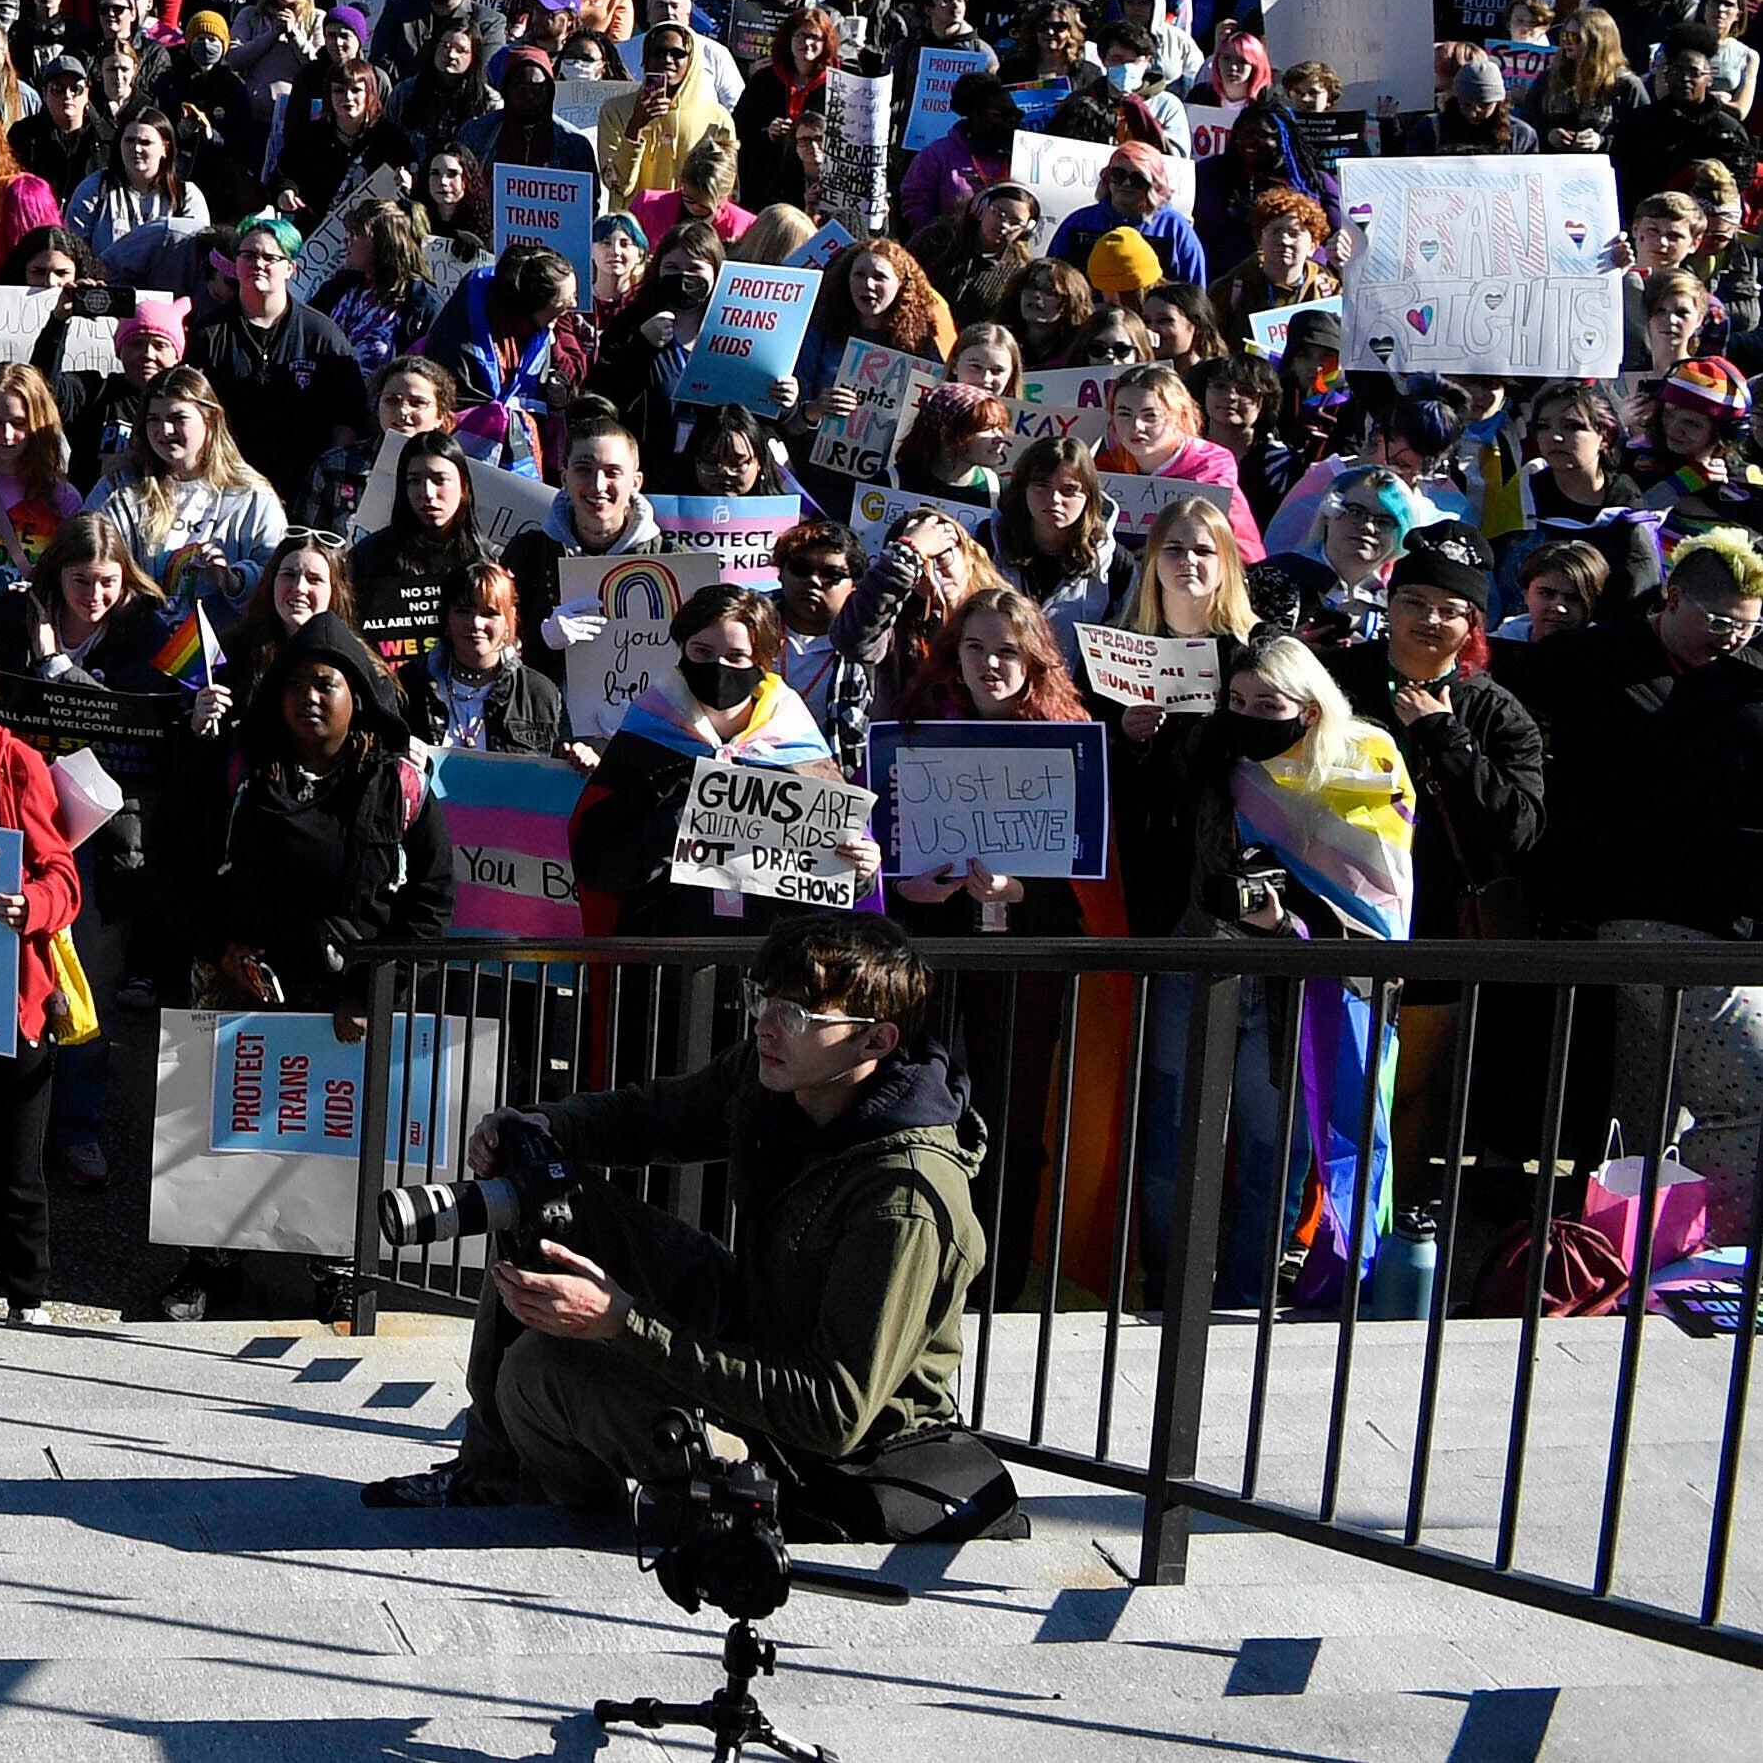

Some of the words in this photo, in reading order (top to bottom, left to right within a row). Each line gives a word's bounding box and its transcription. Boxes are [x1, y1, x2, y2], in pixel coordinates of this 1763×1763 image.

[1462, 10, 1496, 27] DAD
[928, 56, 978, 72] PROTECT
[921, 98, 949, 113] KIDS
[506, 178, 579, 203] PROTECT
[505, 205, 560, 231] TRANS
[1341, 172, 1604, 284] TRANS
[727, 277, 805, 305] PROTECT
[719, 305, 778, 332] TRANS
[1351, 275, 1611, 367] RIGHTS
[707, 333, 753, 358] KIDS
[660, 530, 774, 548] PROTECT
[400, 587, 423, 599] NO
[408, 600, 429, 613] NO
[362, 618, 385, 631] ALL
[386, 616, 412, 629] ARE
[377, 638, 418, 657] WE
[1087, 626, 1159, 658] TRANS
[1110, 653, 1153, 669] RIGHTS
[1159, 666, 1185, 678] ARE
[1096, 669, 1155, 703] HUMAN
[42, 691, 64, 704] NO
[68, 694, 119, 711] SHAME
[48, 704, 72, 717] NO
[74, 708, 112, 722] FEAR
[21, 713, 51, 727] ARE
[51, 717, 125, 736] WELCOME
[126, 726, 165, 739] HERE
[695, 770, 804, 826] GUNS
[804, 790, 865, 832] ARE
[779, 821, 839, 853] KIDS
[972, 809, 1069, 857] LIVE
[674, 838, 737, 867] NOT
[750, 844, 820, 874] DRAG
[773, 875, 850, 906] SHOWS
[231, 1031, 266, 1134] PROTECT
[276, 1053, 310, 1135] TRANS
[323, 1077, 355, 1140] KIDS
